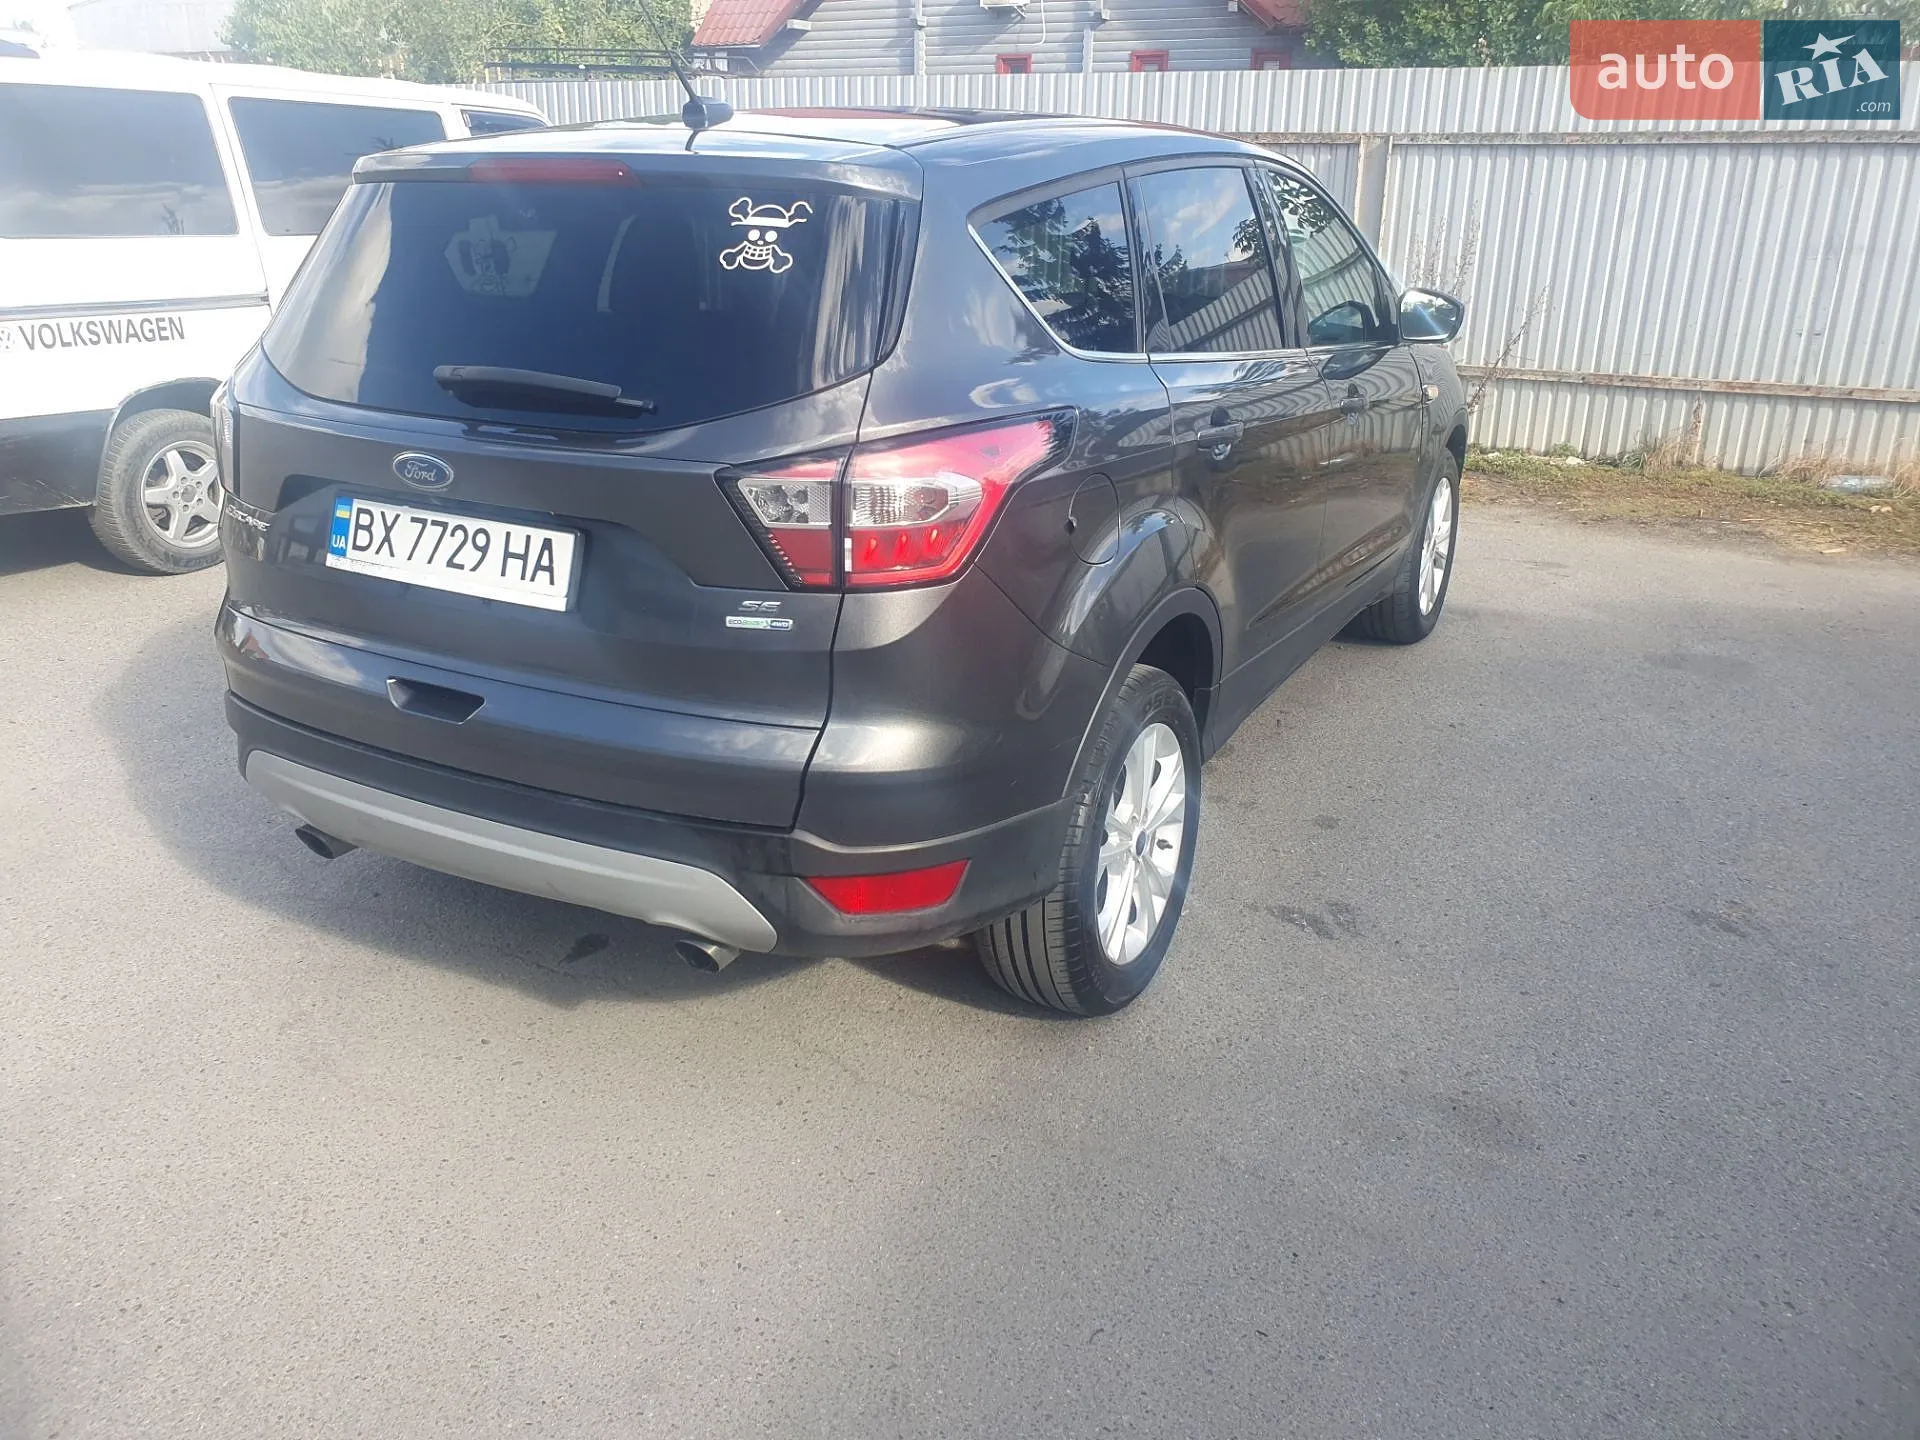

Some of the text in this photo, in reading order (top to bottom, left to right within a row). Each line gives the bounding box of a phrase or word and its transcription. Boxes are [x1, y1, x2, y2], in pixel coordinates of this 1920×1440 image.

[18, 316, 185, 351] VOLKSWAGEN
[404, 460, 437, 482] Ford
[332, 534, 347, 549] UA
[351, 507, 555, 586] BX 7729 HA
[738, 600, 781, 612] SE
